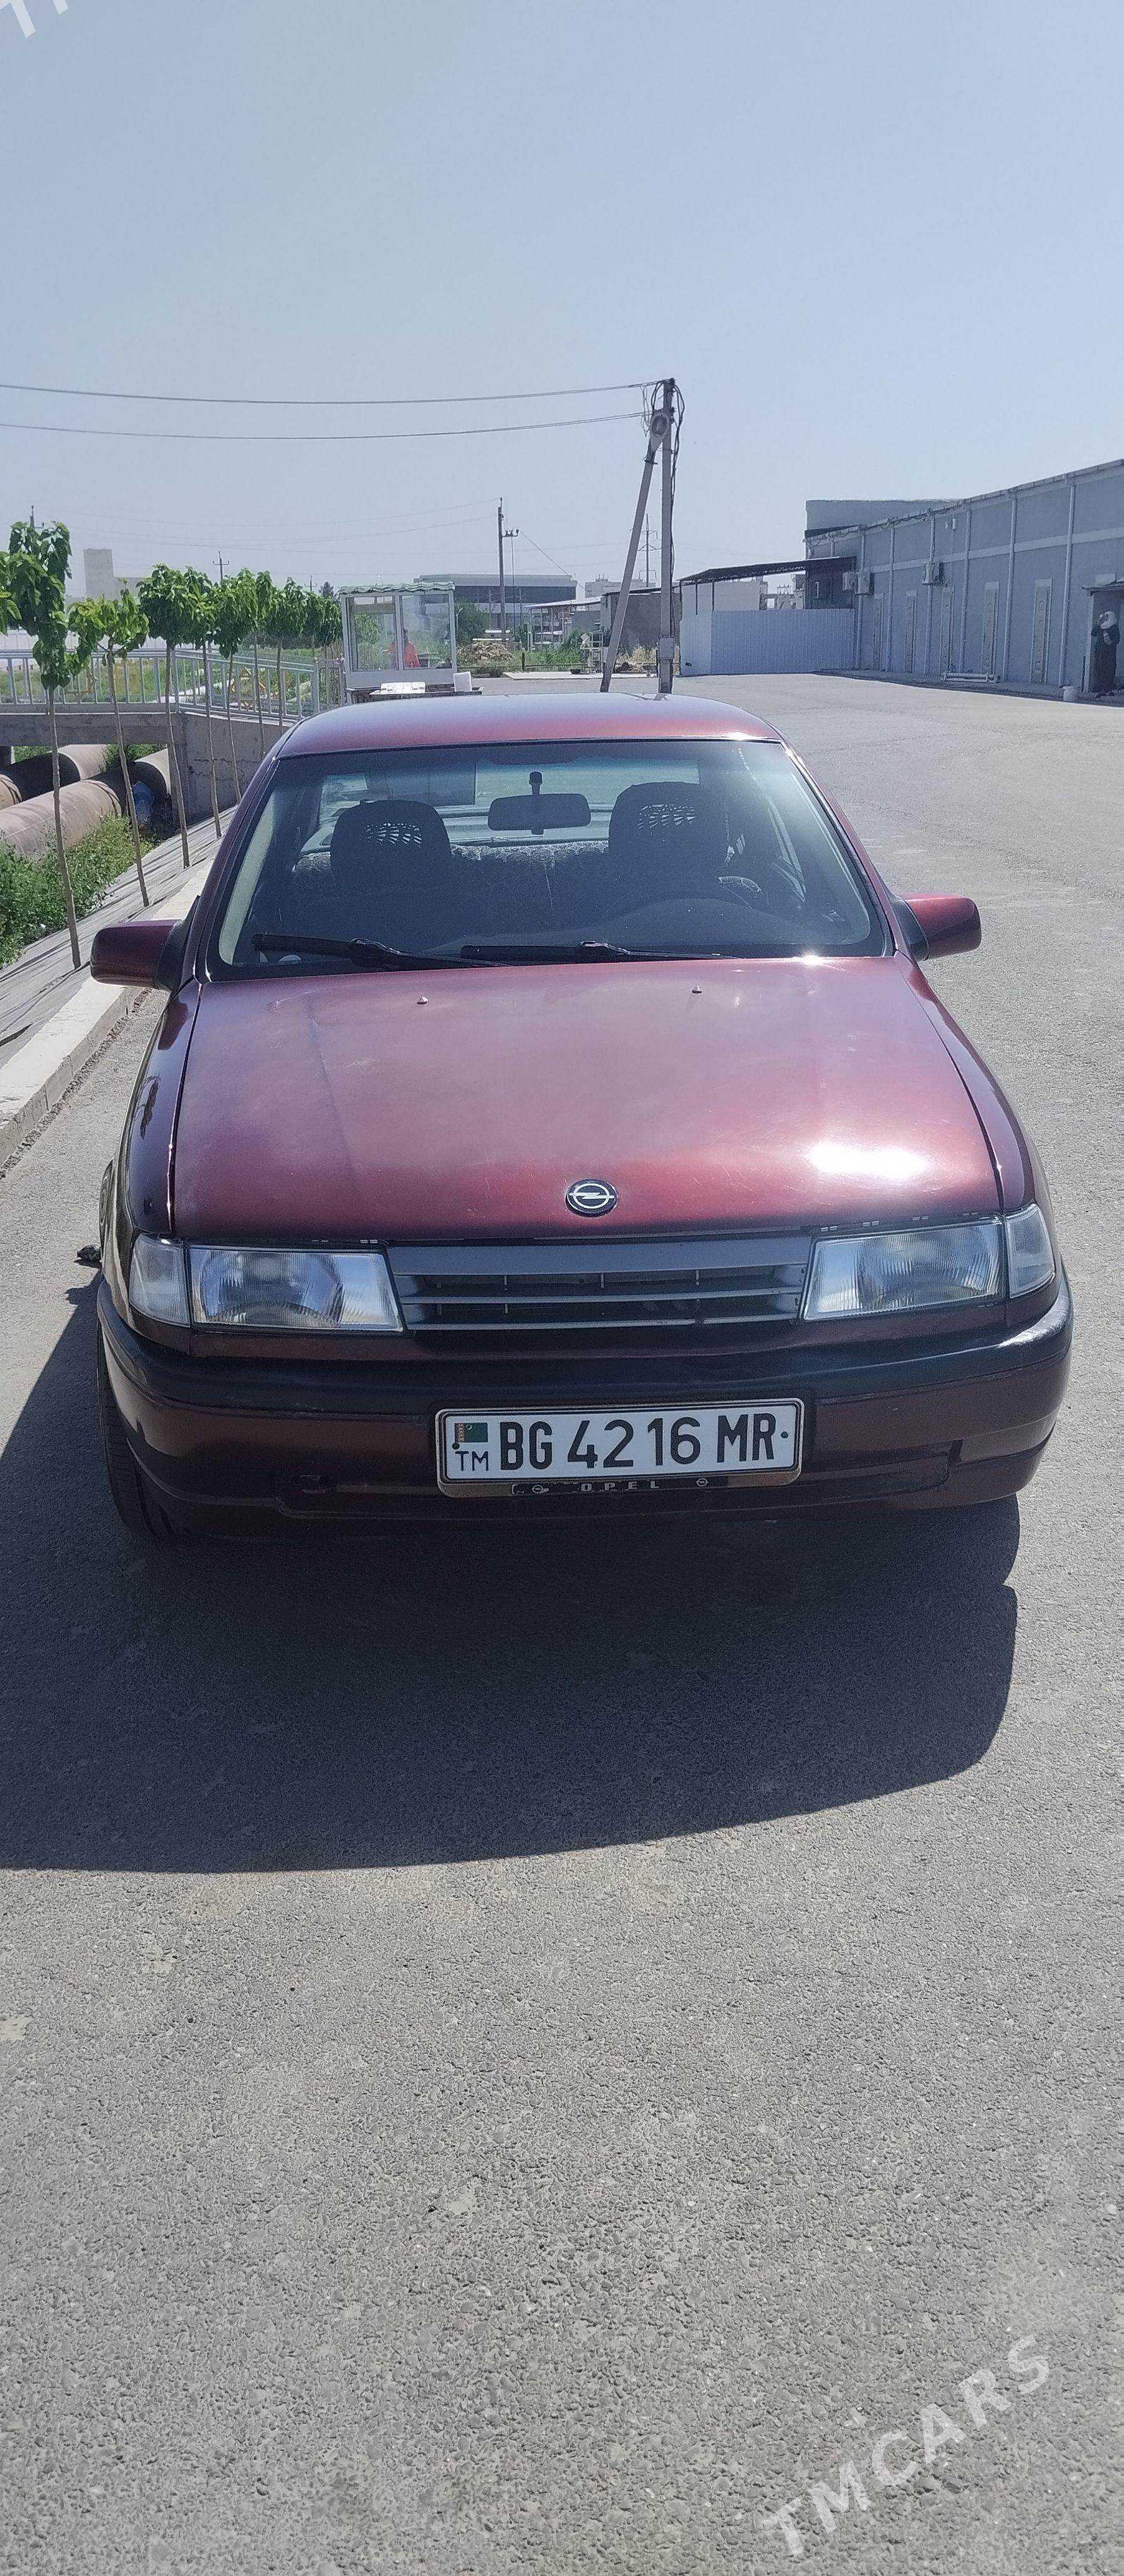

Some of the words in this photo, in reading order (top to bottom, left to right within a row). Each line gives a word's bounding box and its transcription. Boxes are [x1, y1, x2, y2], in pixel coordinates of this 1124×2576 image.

[500, 1421, 553, 1470] BG
[717, 1412, 777, 1464] MR
[455, 1450, 489, 1472] TM
[580, 1480, 660, 1493] OPEL
